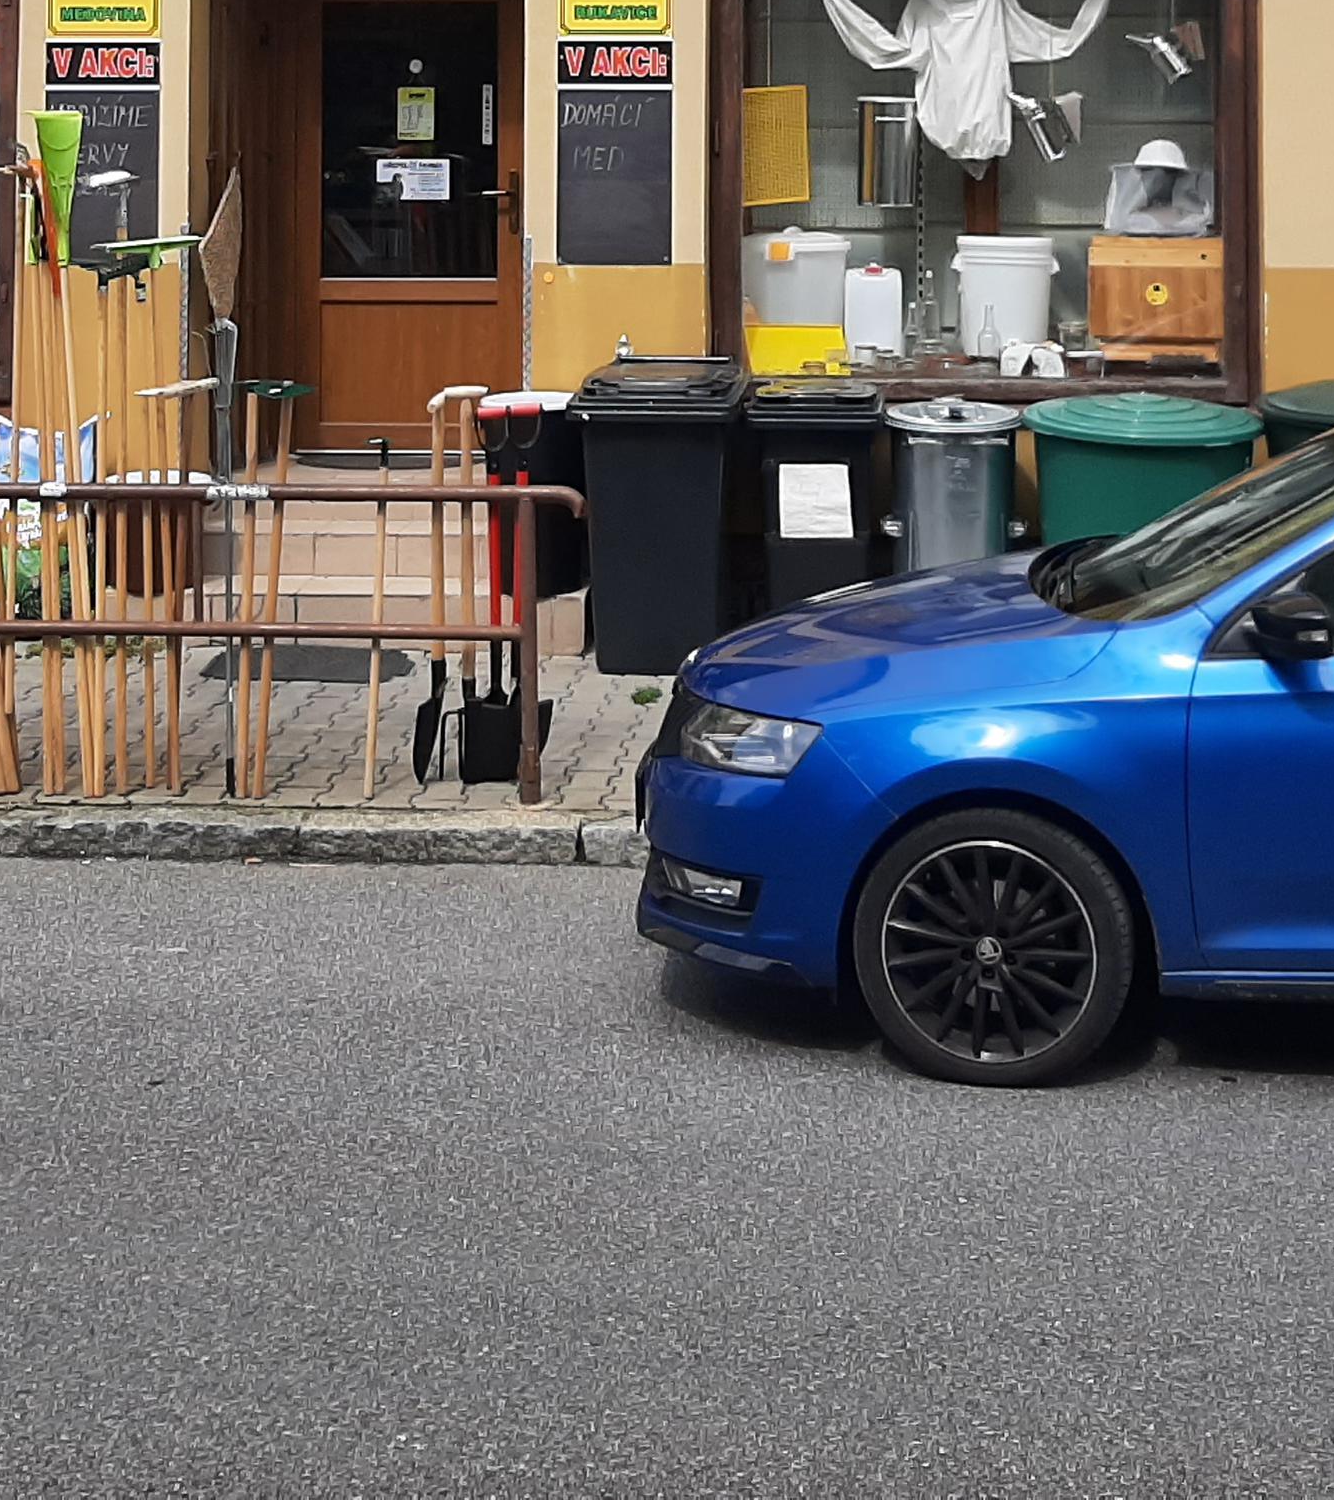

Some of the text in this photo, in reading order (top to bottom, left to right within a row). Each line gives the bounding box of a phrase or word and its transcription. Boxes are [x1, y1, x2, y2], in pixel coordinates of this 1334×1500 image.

[52, 47, 156, 78] V AKCI:
[564, 46, 668, 77] V AKCI:
[561, 94, 656, 128] DOMÁCÍ
